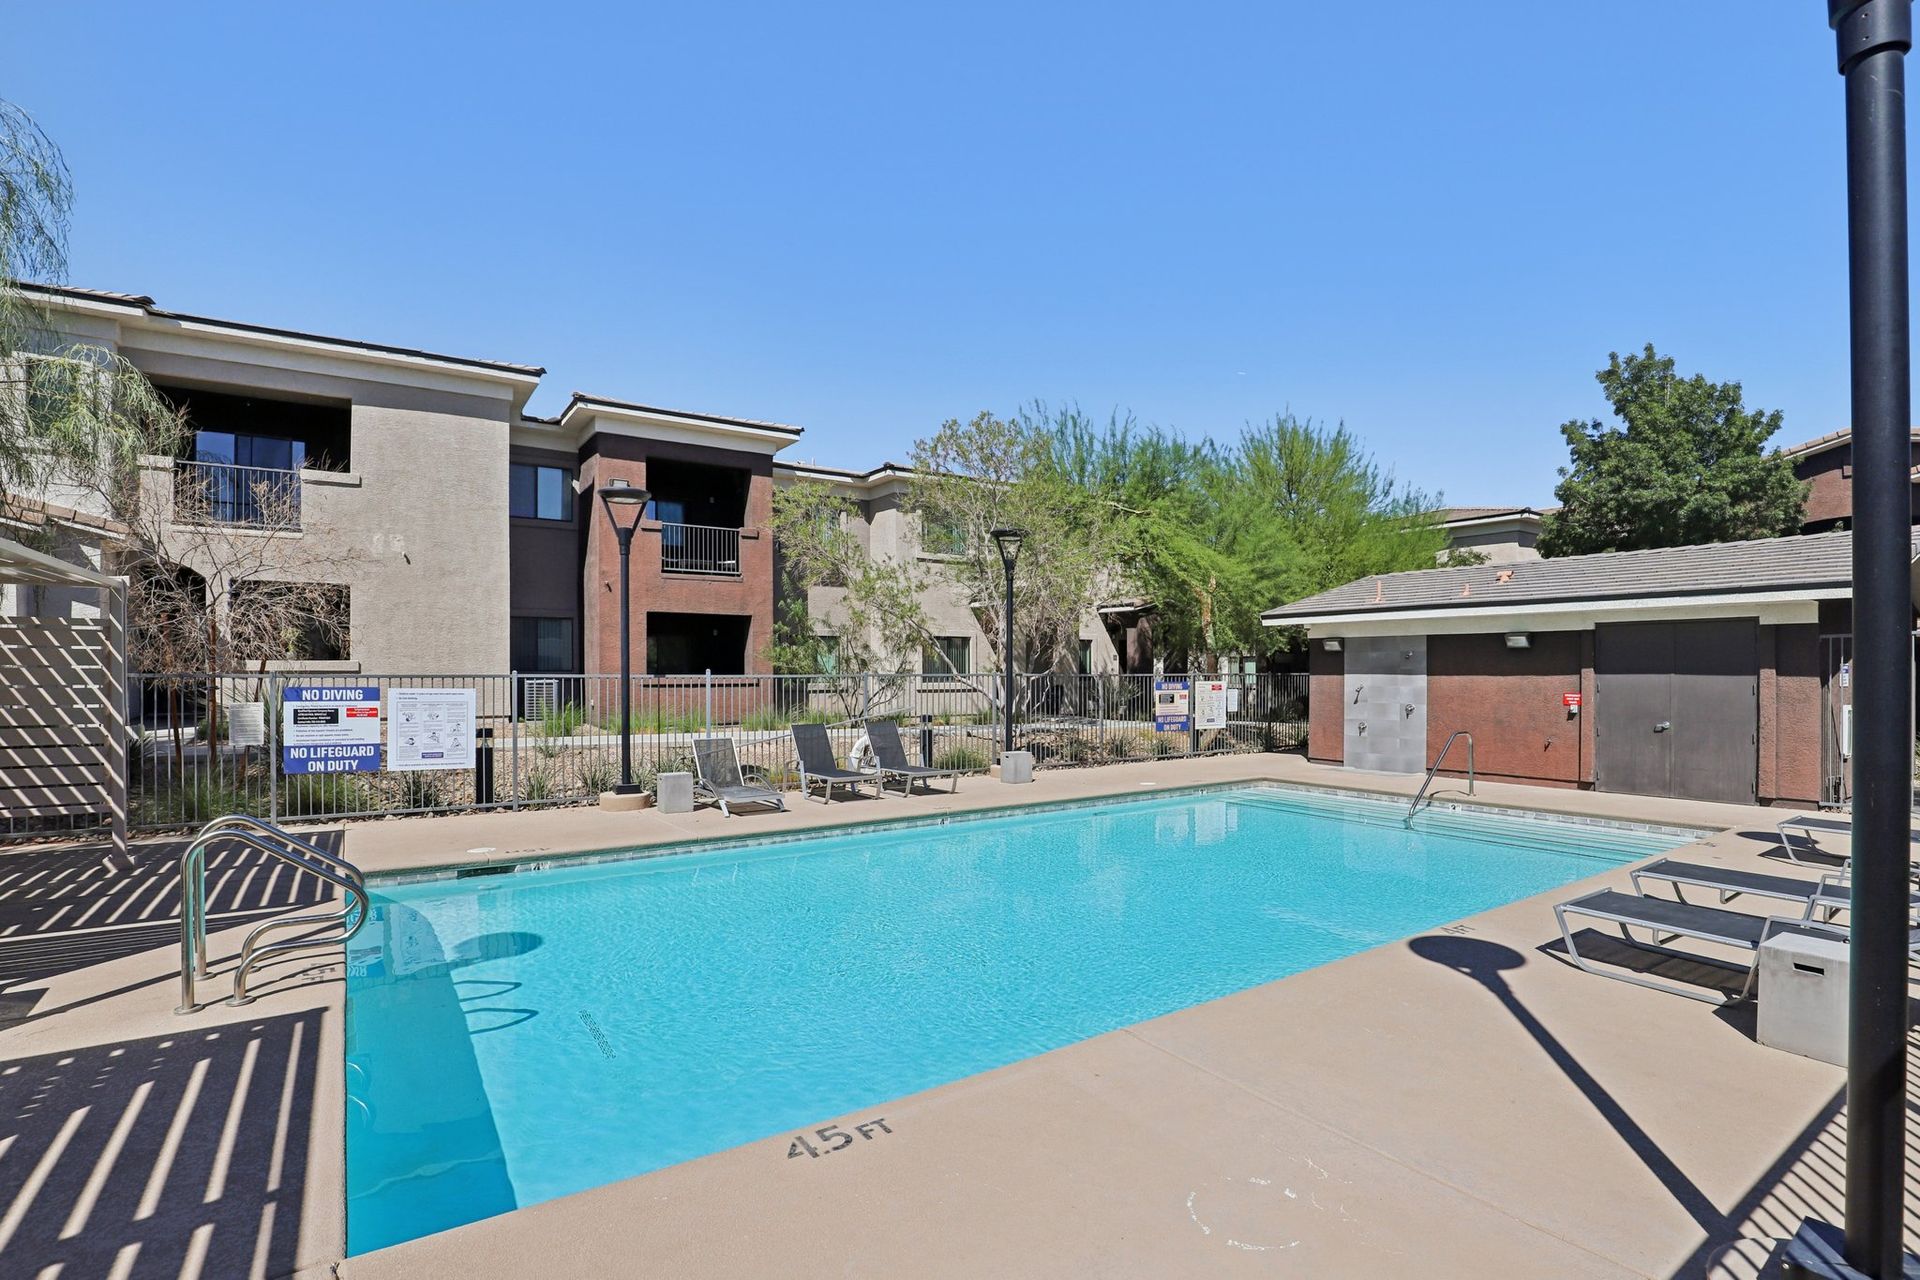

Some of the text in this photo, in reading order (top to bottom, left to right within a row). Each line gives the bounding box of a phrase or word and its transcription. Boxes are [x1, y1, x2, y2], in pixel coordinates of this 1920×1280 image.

[302, 689, 363, 700] NO DIVING
[290, 745, 374, 759] NO LIFEGUARD
[307, 759, 358, 772] ON DUTY
[787, 1117, 893, 1160] 4.5 FT
